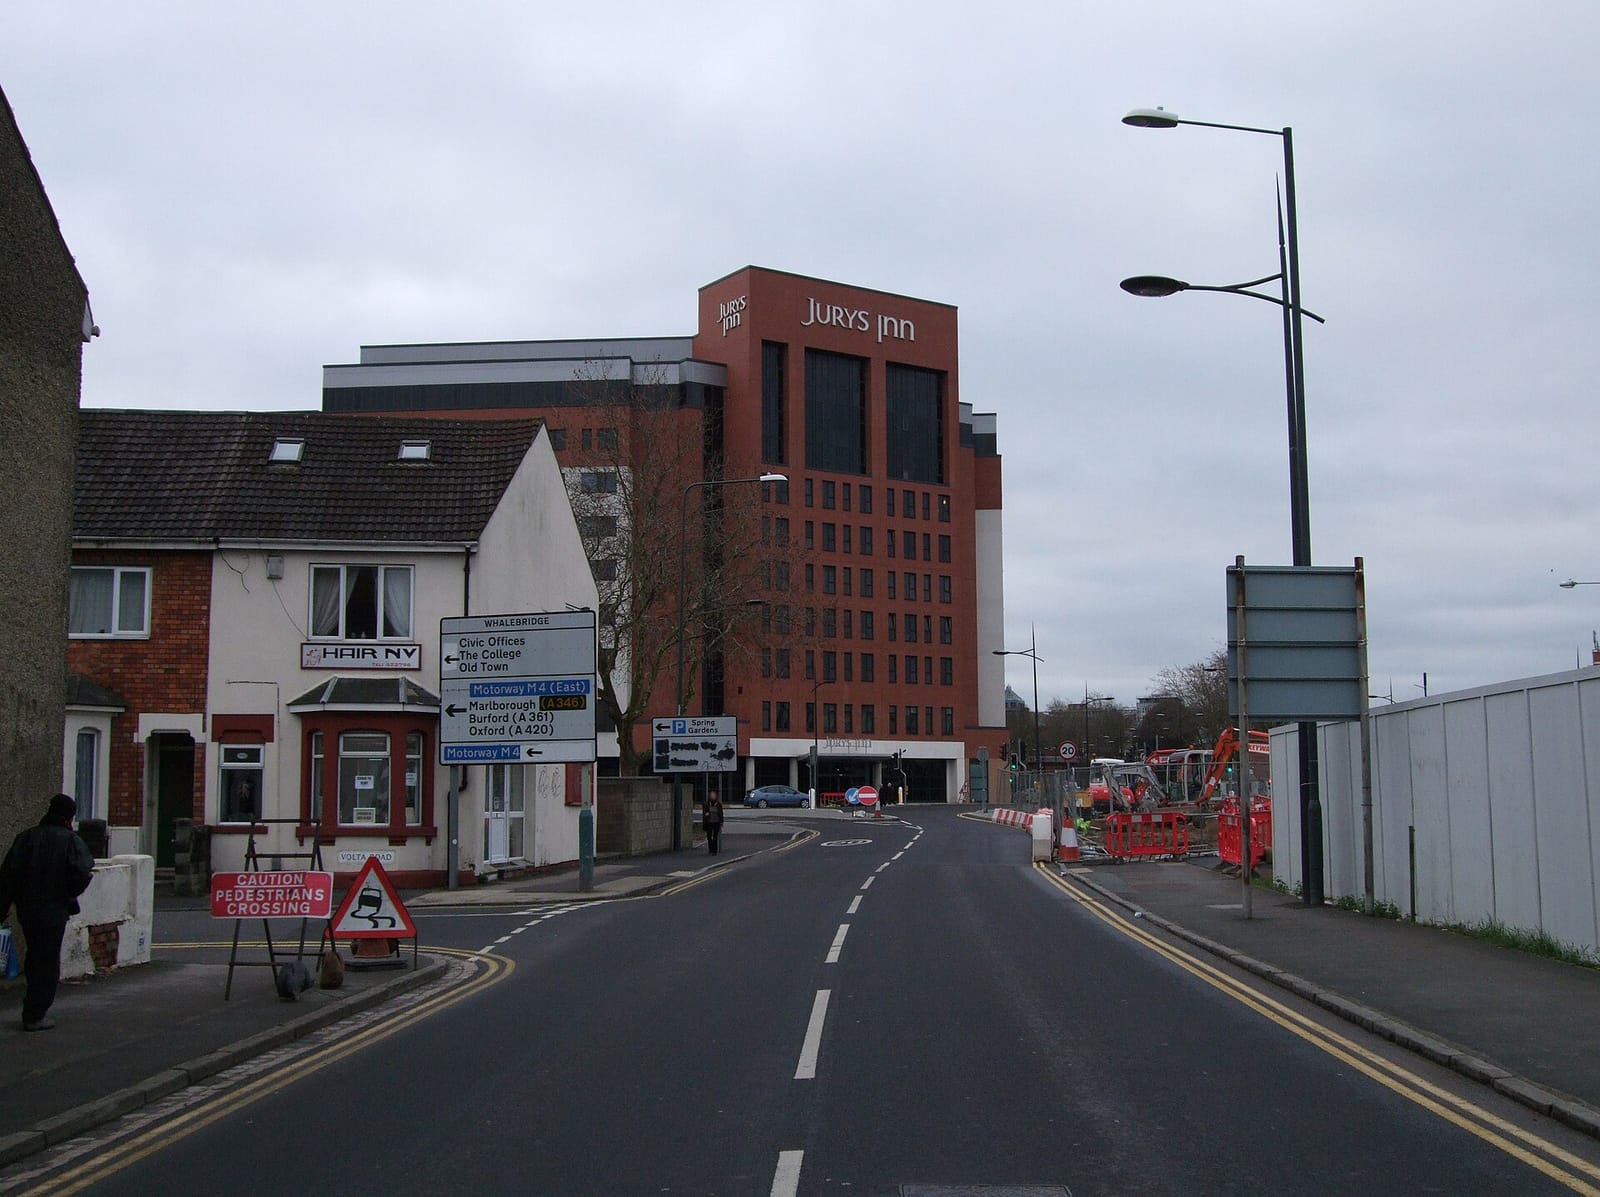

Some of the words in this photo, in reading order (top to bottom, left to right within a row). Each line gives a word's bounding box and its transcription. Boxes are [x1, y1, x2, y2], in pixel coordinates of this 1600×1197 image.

[717, 296, 747, 323] JURYS
[801, 297, 869, 332] JURYS
[484, 617, 550, 628] WHALEBRIDGE
[459, 638, 485, 648] Civic
[488, 636, 526, 647] Offices
[323, 648, 378, 659] HAIR
[384, 648, 417, 659] NV
[459, 651, 478, 660] The
[481, 649, 522, 660] College
[459, 663, 478, 673] Old
[480, 662, 509, 672] Town
[473, 684, 525, 695] Motorway
[550, 681, 586, 694] (East)
[469, 700, 536, 711] Marlborough
[469, 713, 509, 723] Burford
[691, 719, 716, 727] Spring
[469, 725, 505, 736] Oxford
[447, 748, 498, 759] Motorway
[1062, 746, 1075, 755] 20
[340, 853, 366, 861] VOLTA
[237, 873, 303, 886] CAUTION
[216, 888, 325, 902] PEDESTRIANS
[227, 902, 310, 915] CROSSING
